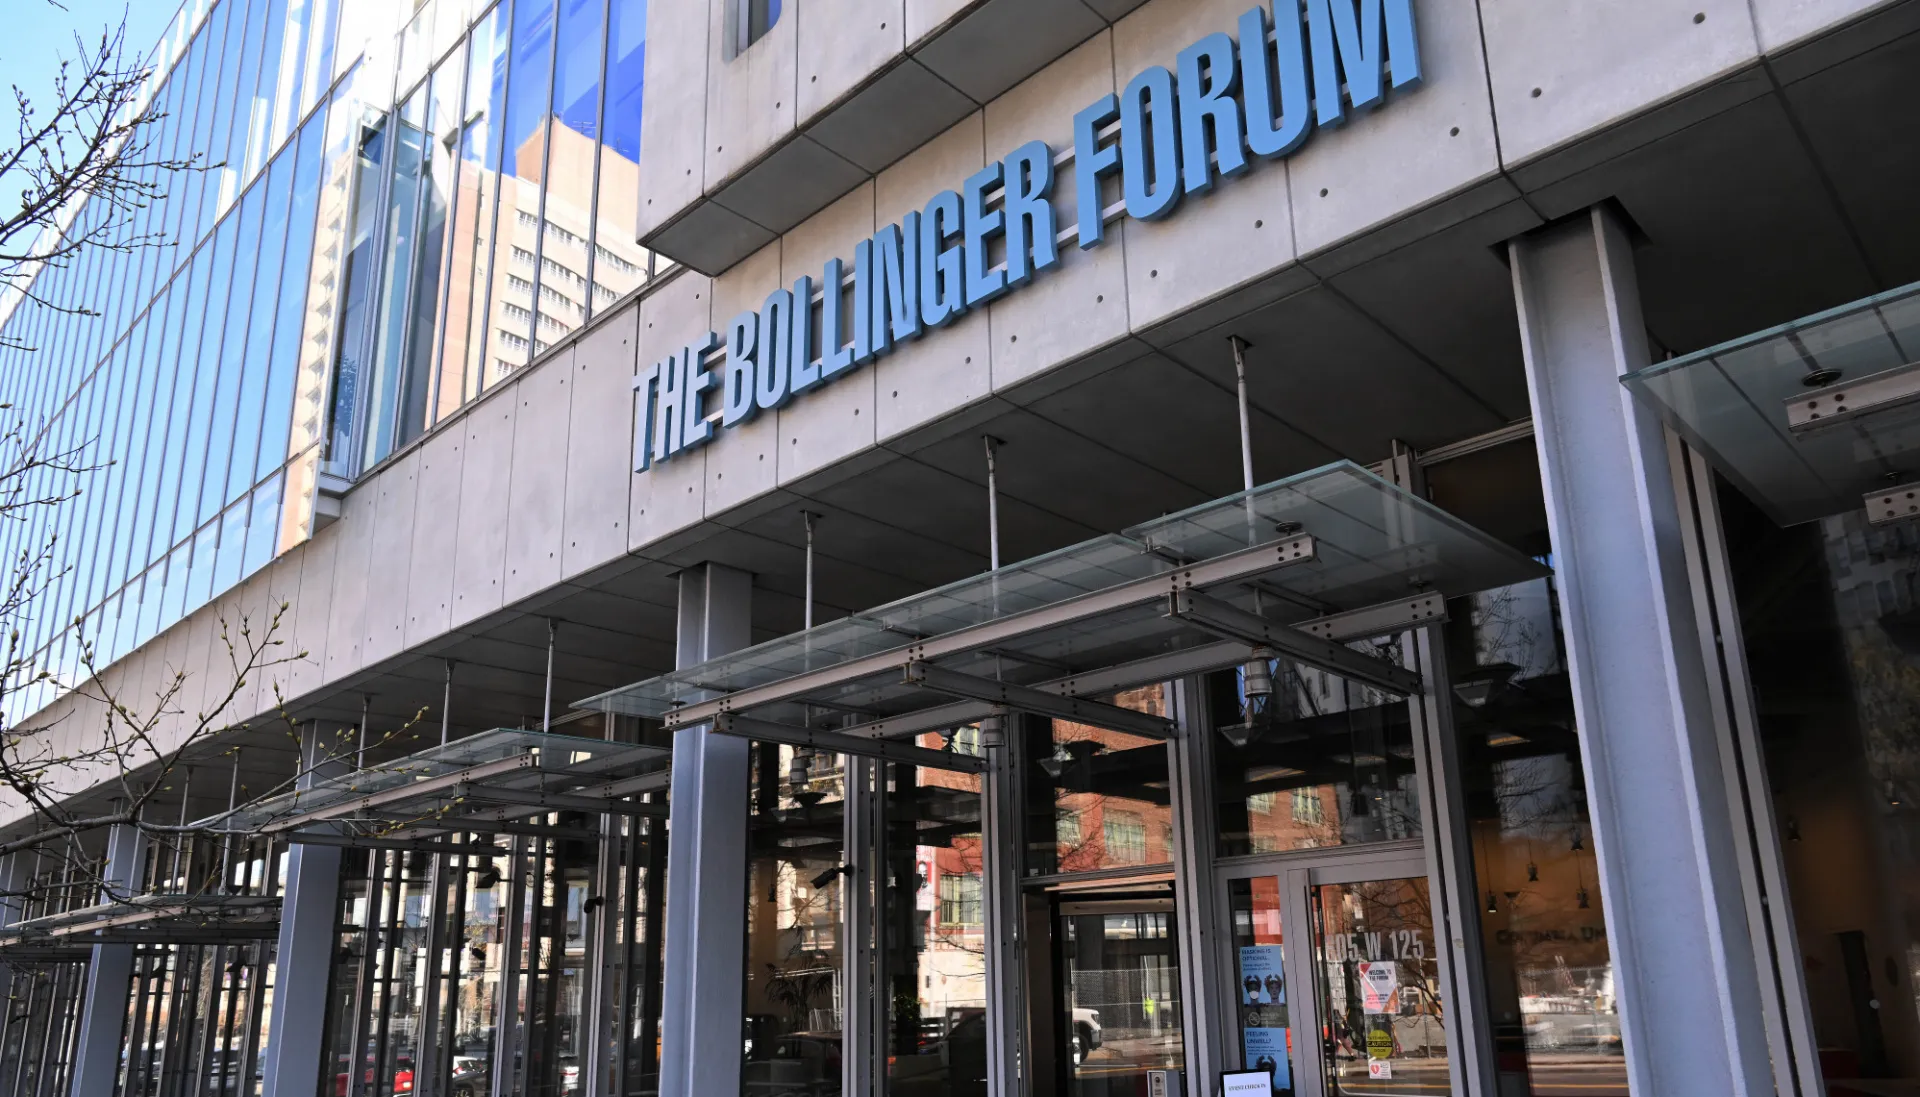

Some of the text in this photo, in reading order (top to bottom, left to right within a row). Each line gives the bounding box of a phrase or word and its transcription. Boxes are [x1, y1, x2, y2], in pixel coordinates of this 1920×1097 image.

[632, 0, 1423, 474] THE BOLLINGER FORUM
[1364, 931, 1381, 960] W
[1389, 929, 1425, 960] 125
